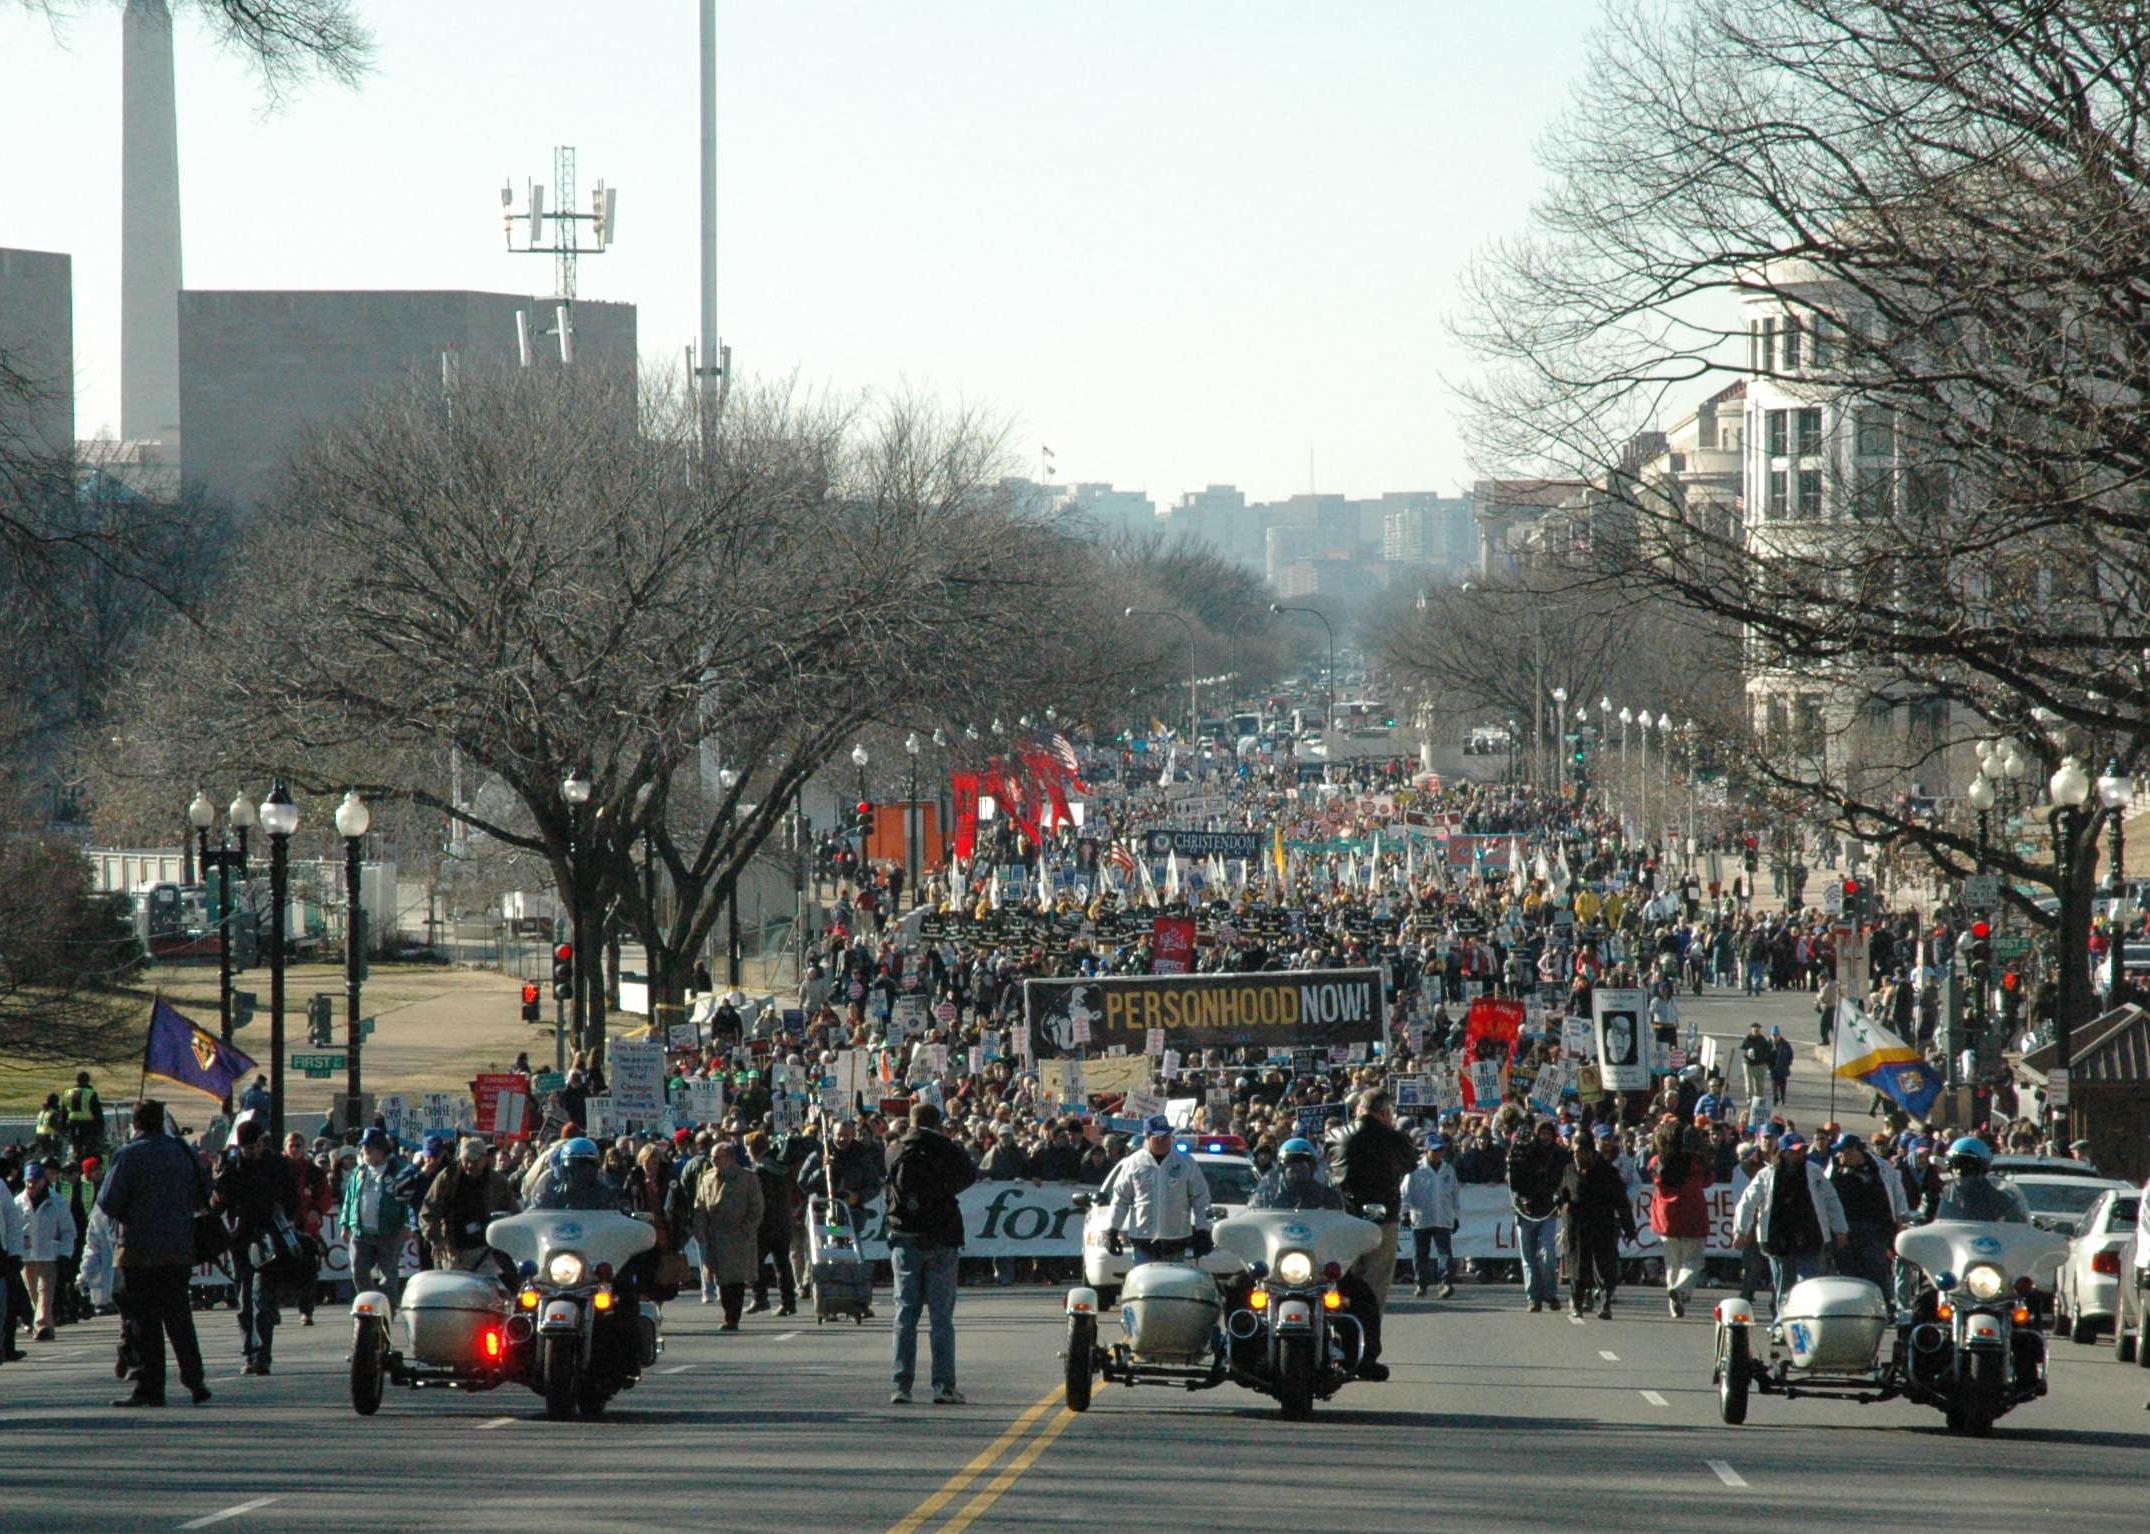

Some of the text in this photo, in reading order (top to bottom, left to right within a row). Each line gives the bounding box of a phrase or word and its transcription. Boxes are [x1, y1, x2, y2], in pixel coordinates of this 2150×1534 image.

[1173, 833, 1256, 850] CHRISTENDOM
[1104, 981, 1371, 1031] PERSONHOOD NOW!
[293, 1055, 331, 1069] FIRST
[424, 1104, 450, 1117] CHOOSE
[975, 1188, 1087, 1241] for
[1707, 1190, 1734, 1217] HE
